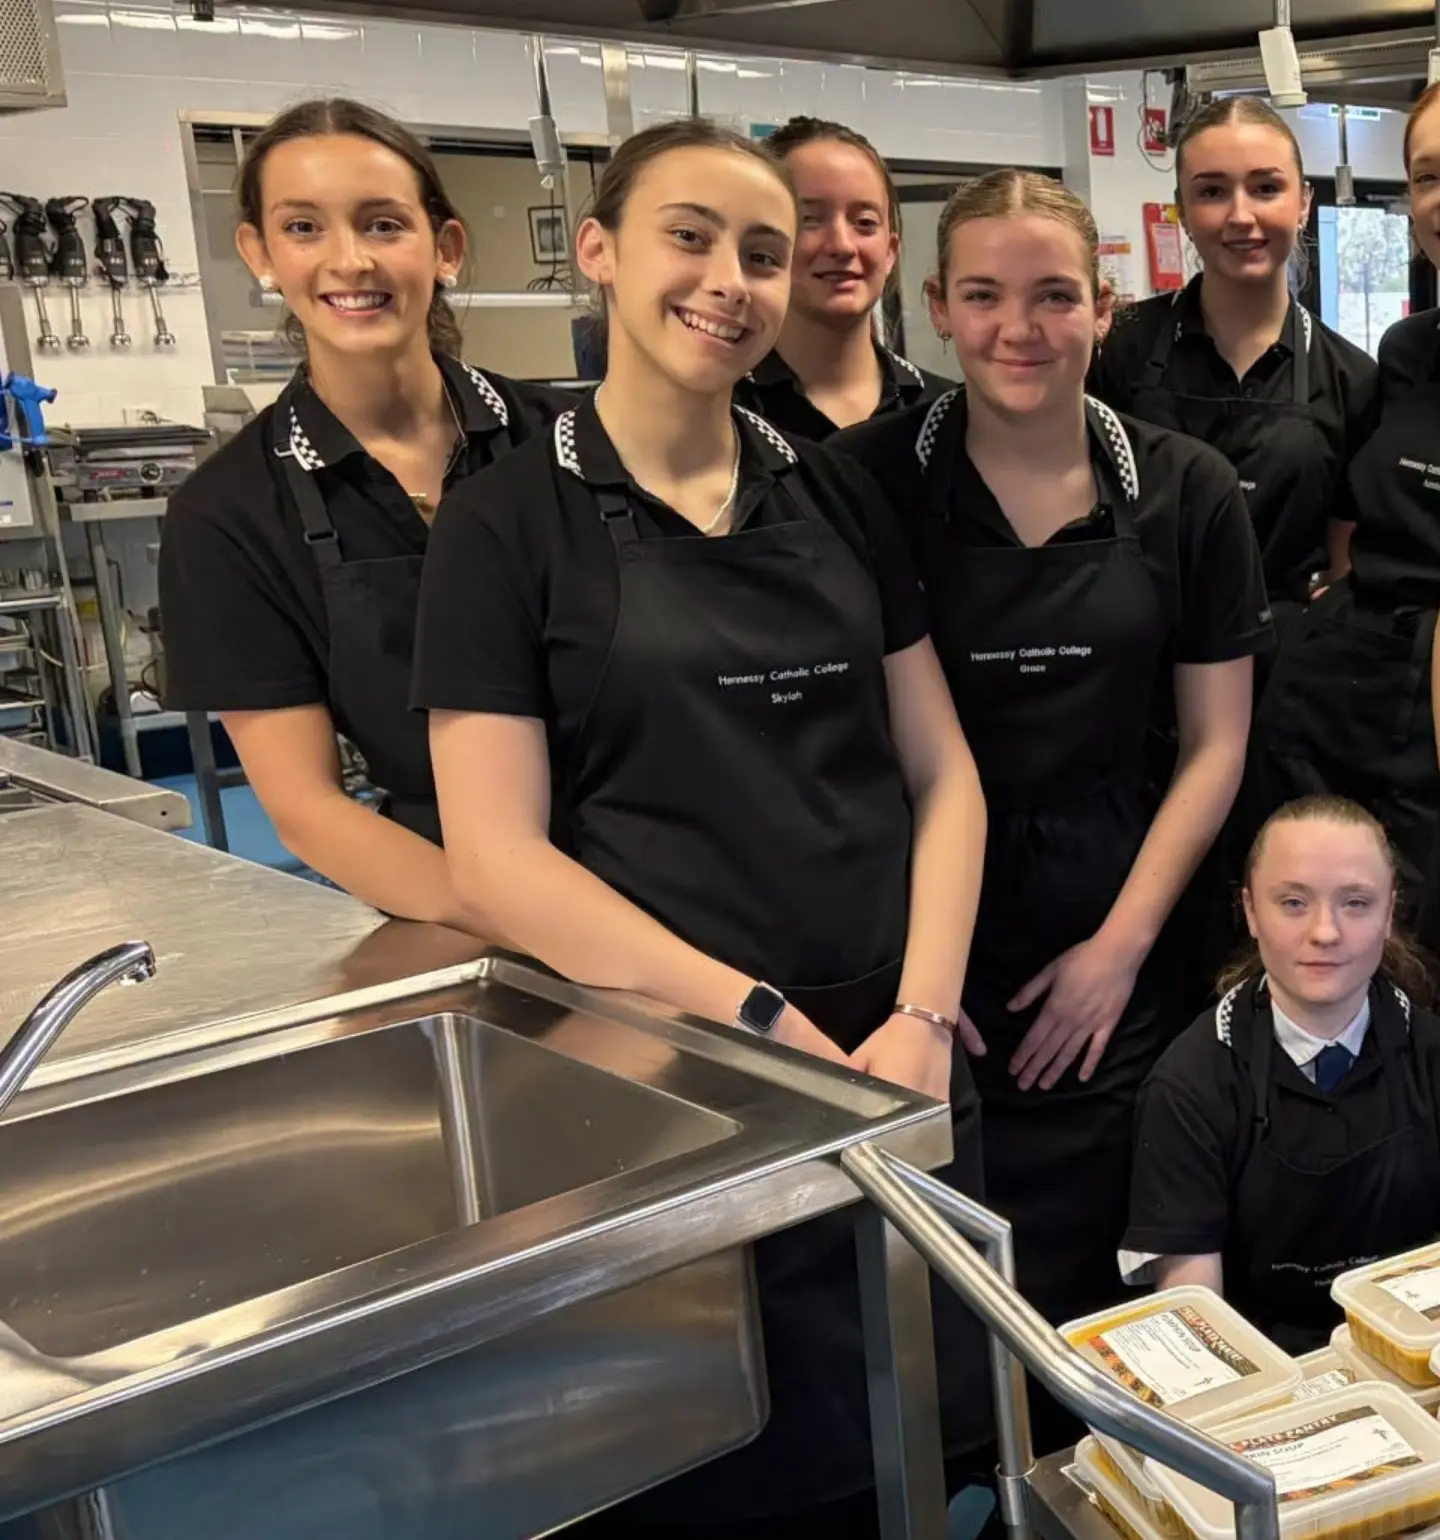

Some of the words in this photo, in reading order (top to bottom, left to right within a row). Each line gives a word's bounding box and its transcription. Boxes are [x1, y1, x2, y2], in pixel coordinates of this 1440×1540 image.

[717, 674, 766, 686] Hennessy
[769, 667, 810, 682] Catholic
[813, 661, 849, 675] College
[770, 690, 803, 704] Skylah
[1285, 1414, 1337, 1438] PANTRY
